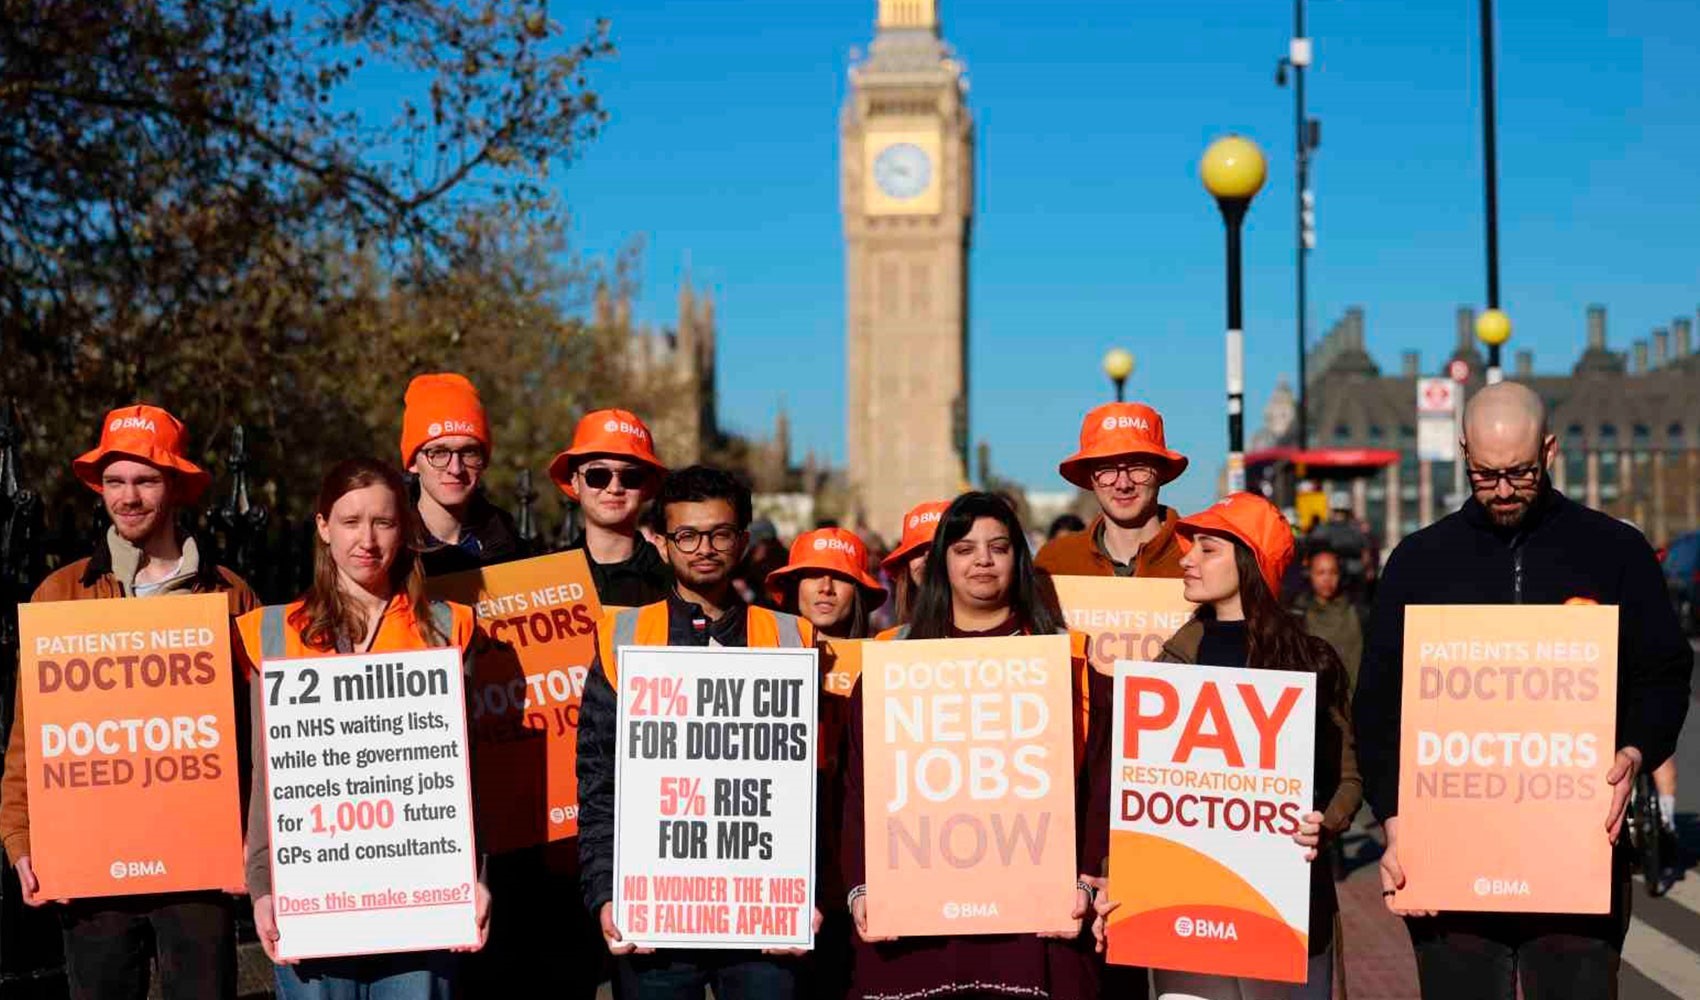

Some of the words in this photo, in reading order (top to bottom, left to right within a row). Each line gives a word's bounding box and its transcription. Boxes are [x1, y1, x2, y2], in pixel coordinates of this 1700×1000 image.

[123, 418, 156, 434] BMA
[444, 421, 474, 432] BMA
[620, 422, 647, 440] BMA
[1118, 416, 1149, 430] BMA
[920, 512, 942, 524] BM
[828, 539, 854, 555] BMA
[530, 582, 584, 608] NEED
[36, 631, 145, 655] PATIENTS
[150, 628, 215, 651] NEED
[1420, 642, 1529, 662] PATIENTS
[1536, 642, 1600, 662] NEED
[38, 652, 216, 693] DOCTORS
[264, 668, 321, 706] 7.2
[333, 662, 448, 702] million
[884, 658, 1048, 690] DOCTORS
[1419, 666, 1600, 702] DOCTORS
[630, 676, 688, 716] 21%
[696, 678, 745, 718] PAY
[752, 678, 803, 718] CUT
[270, 724, 292, 740] on
[297, 718, 335, 738] NHS
[340, 714, 404, 736] waiting
[408, 712, 450, 731] lists,
[884, 692, 1050, 744] NEED
[1122, 676, 1304, 770] PAY
[41, 715, 220, 758] DOCTORS
[628, 720, 678, 760] FOR
[686, 722, 807, 762] DOCTORS
[1417, 730, 1598, 768] DOCTORS
[271, 750, 317, 770] while
[322, 748, 350, 766] the
[356, 740, 458, 768] government
[43, 757, 135, 790] NEED
[141, 754, 222, 789] JOBS
[273, 779, 341, 800] cancels
[346, 774, 414, 796] training
[418, 772, 454, 794] jobs
[886, 744, 1052, 813] JOBS
[1122, 766, 1260, 793] RESTORATION
[1262, 776, 1302, 796] FOR
[1415, 772, 1506, 799] NEED
[1514, 772, 1596, 804] JOBS
[660, 776, 706, 816] 5%
[714, 778, 772, 817] RISE
[277, 814, 304, 832] for
[310, 800, 394, 838] 1,000
[404, 803, 456, 822] future
[1120, 789, 1302, 837] DOCTORS
[277, 847, 312, 865] GPs
[317, 842, 350, 862] and
[355, 836, 462, 860] consultants.
[658, 820, 708, 860] FOR
[716, 822, 773, 860] MPs
[886, 812, 1052, 870] NOW
[128, 861, 166, 876] BMA
[278, 895, 320, 914] Does
[325, 892, 356, 910] this
[362, 888, 408, 908] make
[412, 882, 470, 904] sense?
[624, 876, 648, 902] NO
[652, 876, 728, 902] WONDER
[732, 877, 764, 903] THE
[769, 877, 806, 904] NHS
[1493, 880, 1530, 896] BMA
[627, 904, 648, 933] IS
[654, 904, 730, 935] FALLING
[736, 906, 800, 936] APART
[962, 903, 998, 918] BMA
[1196, 919, 1238, 940] BMA
